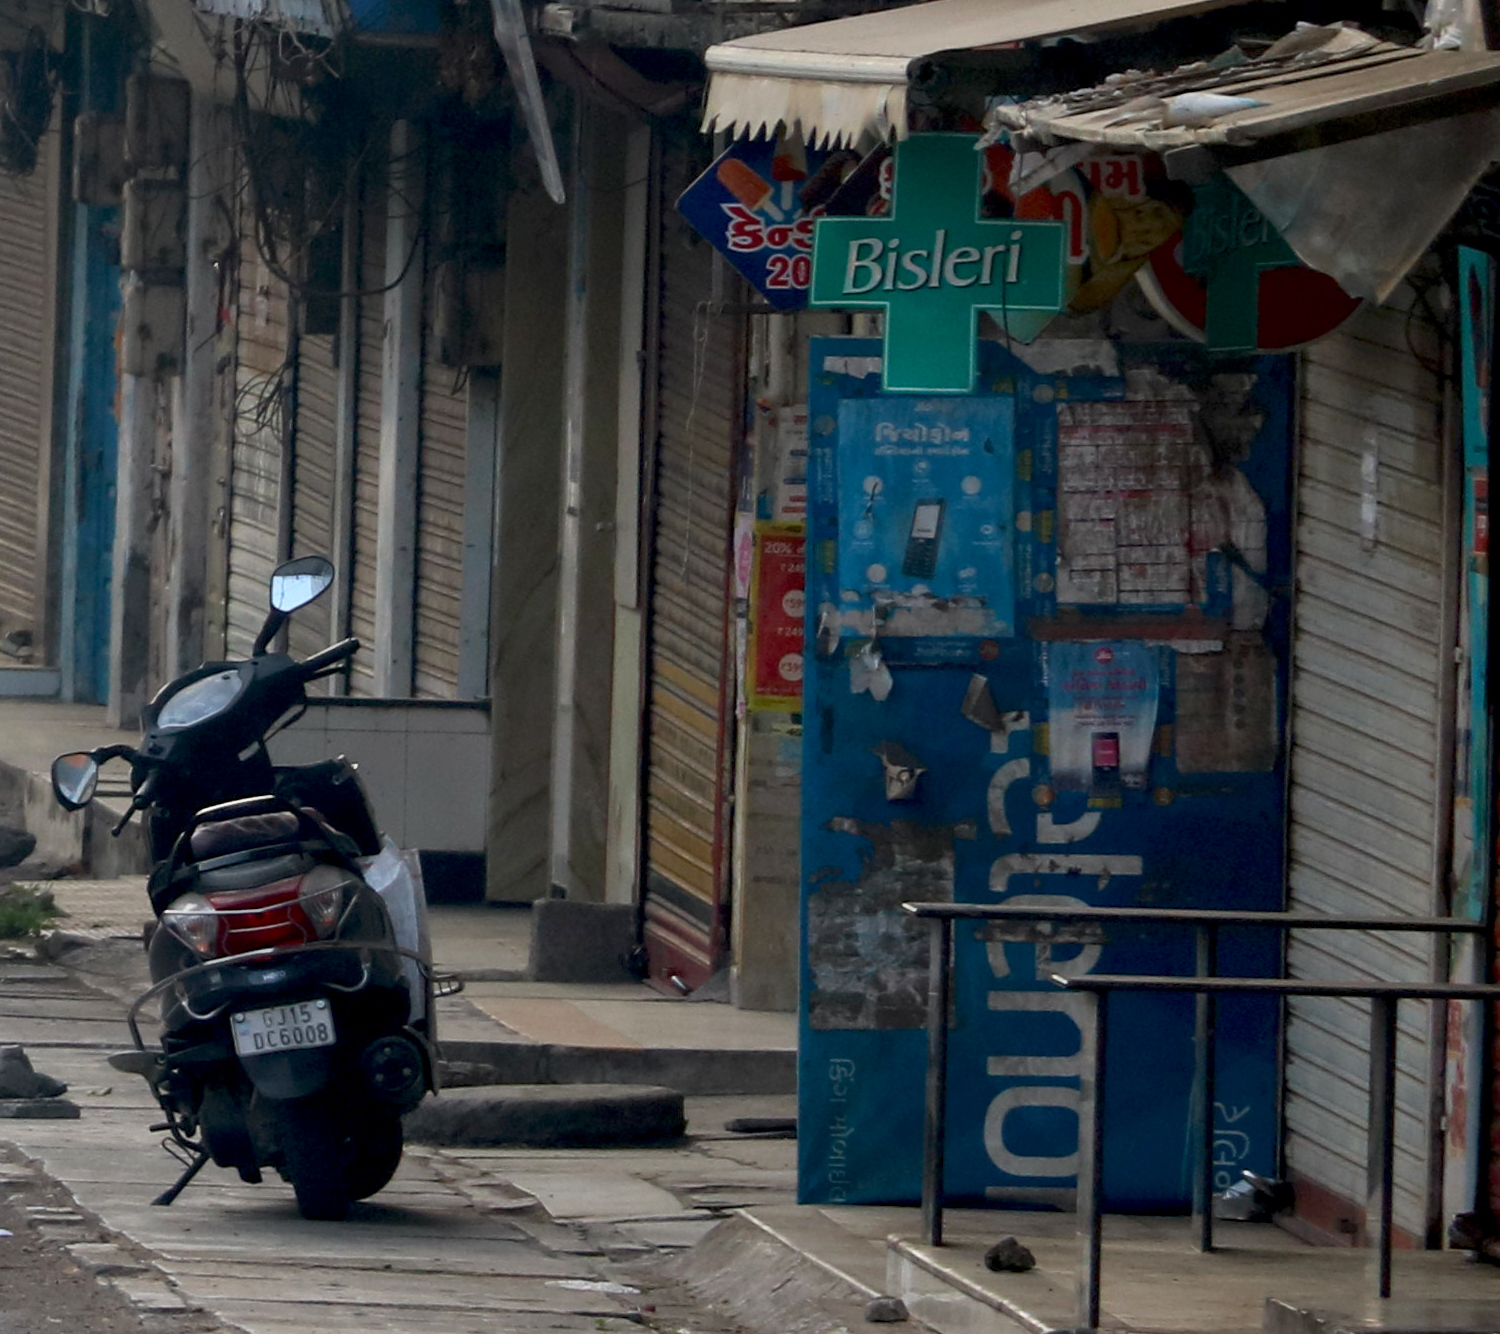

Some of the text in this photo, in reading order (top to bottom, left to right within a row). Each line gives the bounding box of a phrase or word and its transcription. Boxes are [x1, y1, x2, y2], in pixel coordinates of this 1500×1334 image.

[841, 227, 1024, 296] Bisleri
[764, 540, 793, 556] 20%
[261, 1004, 312, 1028] GJ15
[252, 1022, 329, 1050] DC6008
